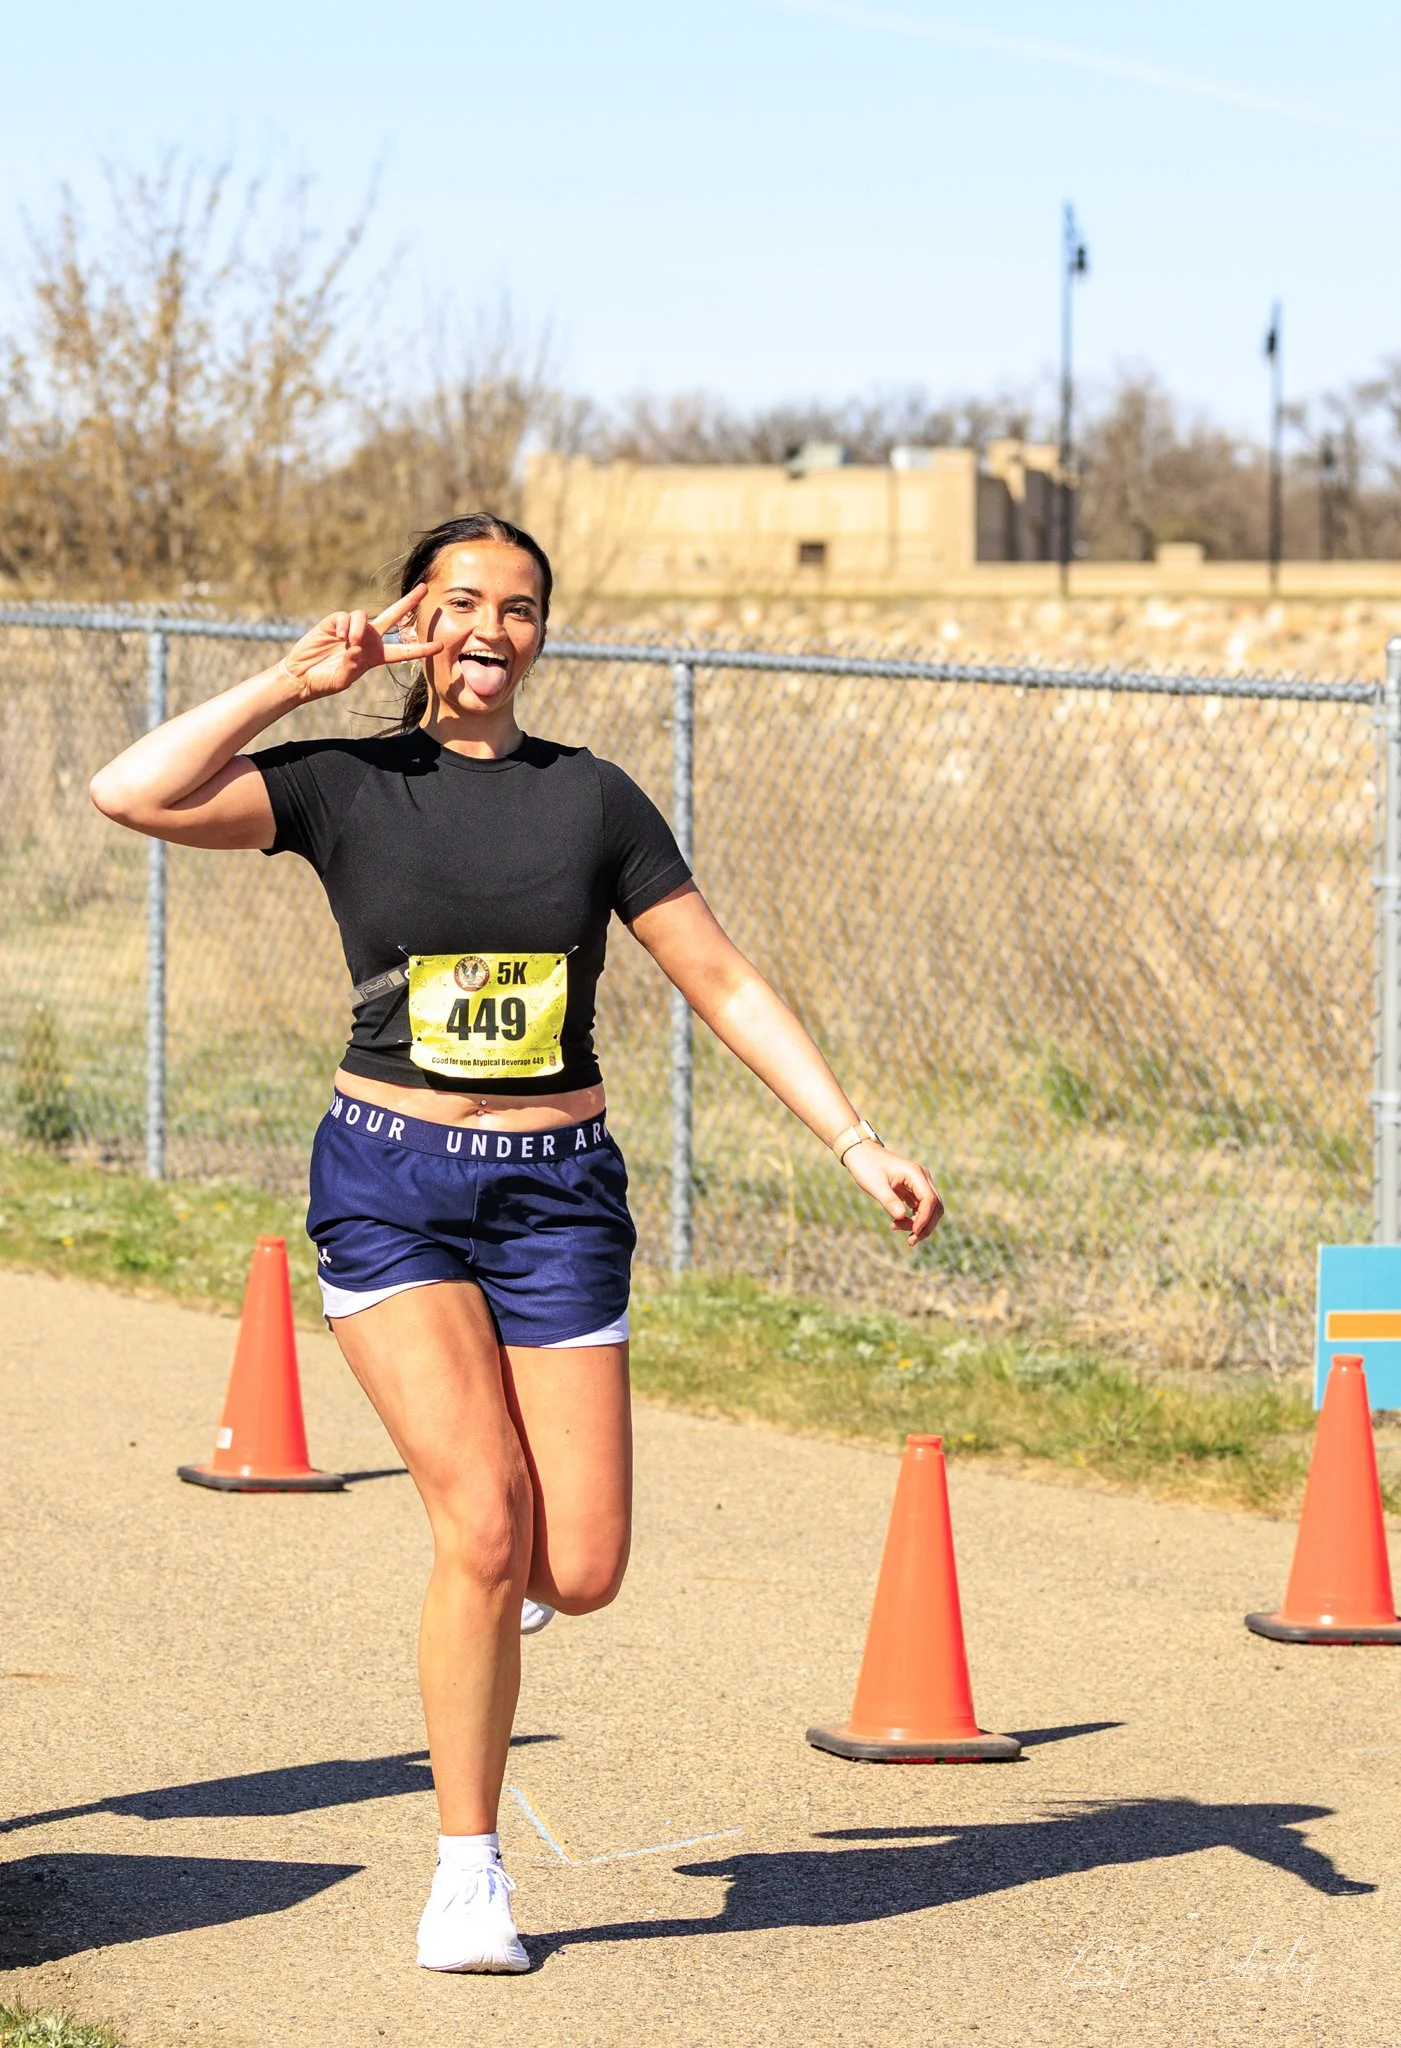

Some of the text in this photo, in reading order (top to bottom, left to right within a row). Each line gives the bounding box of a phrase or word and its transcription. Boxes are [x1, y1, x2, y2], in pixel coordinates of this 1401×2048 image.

[497, 961, 527, 985] 5K
[446, 997, 526, 1041] 449
[432, 1056, 544, 1067] Good for one Atypical Beverage 449
[446, 1131, 555, 1158] UNDER
